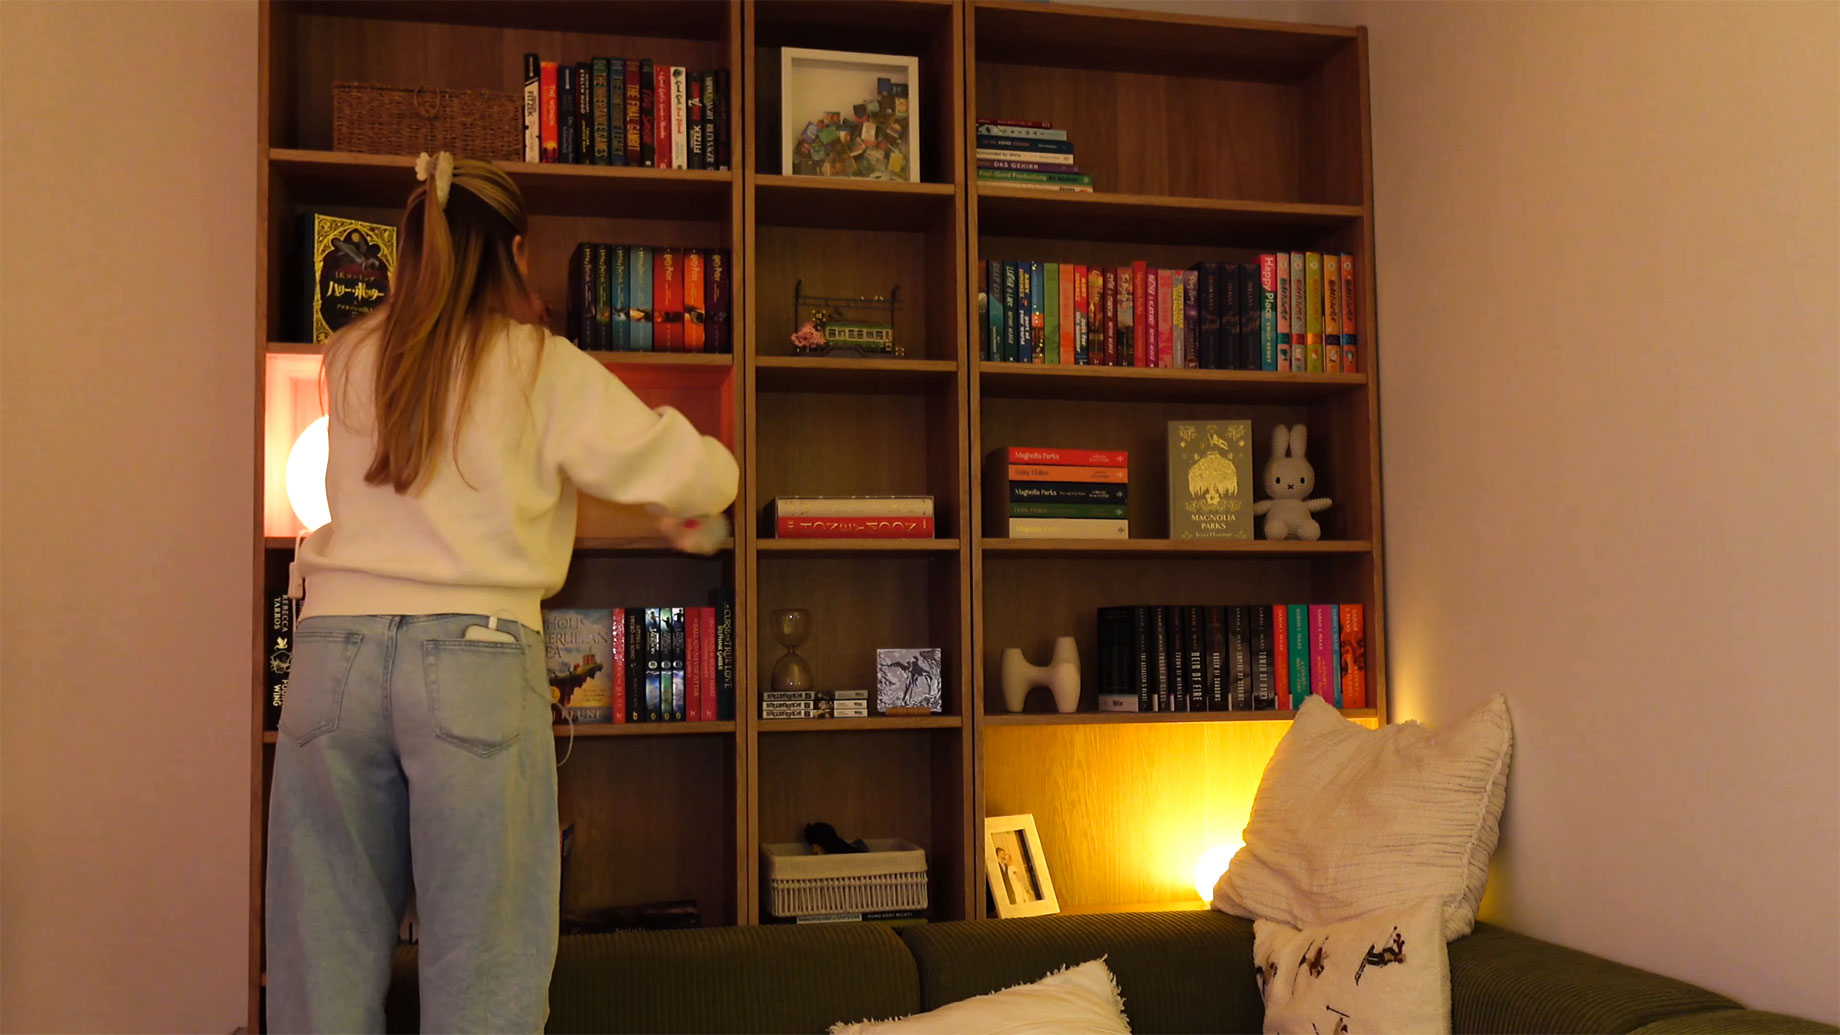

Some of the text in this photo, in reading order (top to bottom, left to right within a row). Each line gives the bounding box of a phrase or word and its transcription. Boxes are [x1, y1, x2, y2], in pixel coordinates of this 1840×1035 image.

[627, 84, 640, 99] THE
[627, 100, 640, 122] FINAL
[627, 124, 640, 152] GAMBIT
[693, 125, 702, 153] FITZEK
[993, 160, 1039, 171] DAS GEHIRN
[1262, 256, 1274, 319] Happy Place
[1015, 450, 1060, 462] Magnolia Parks
[1014, 487, 1057, 498] Magnolia Parks
[273, 597, 281, 630] YARROS
[281, 594, 289, 633] REBECCA
[1351, 609, 1359, 632] SARAH
[723, 609, 732, 689] CURSE TRUE LOVE
[1236, 652, 1244, 671] EMPIRE
[1258, 651, 1268, 672] TOWER
[1191, 652, 1203, 701] HEIR OF FIRE
[1259, 673, 1268, 681] OF
[272, 684, 281, 707] WING
[1236, 680, 1245, 701] STORMS
